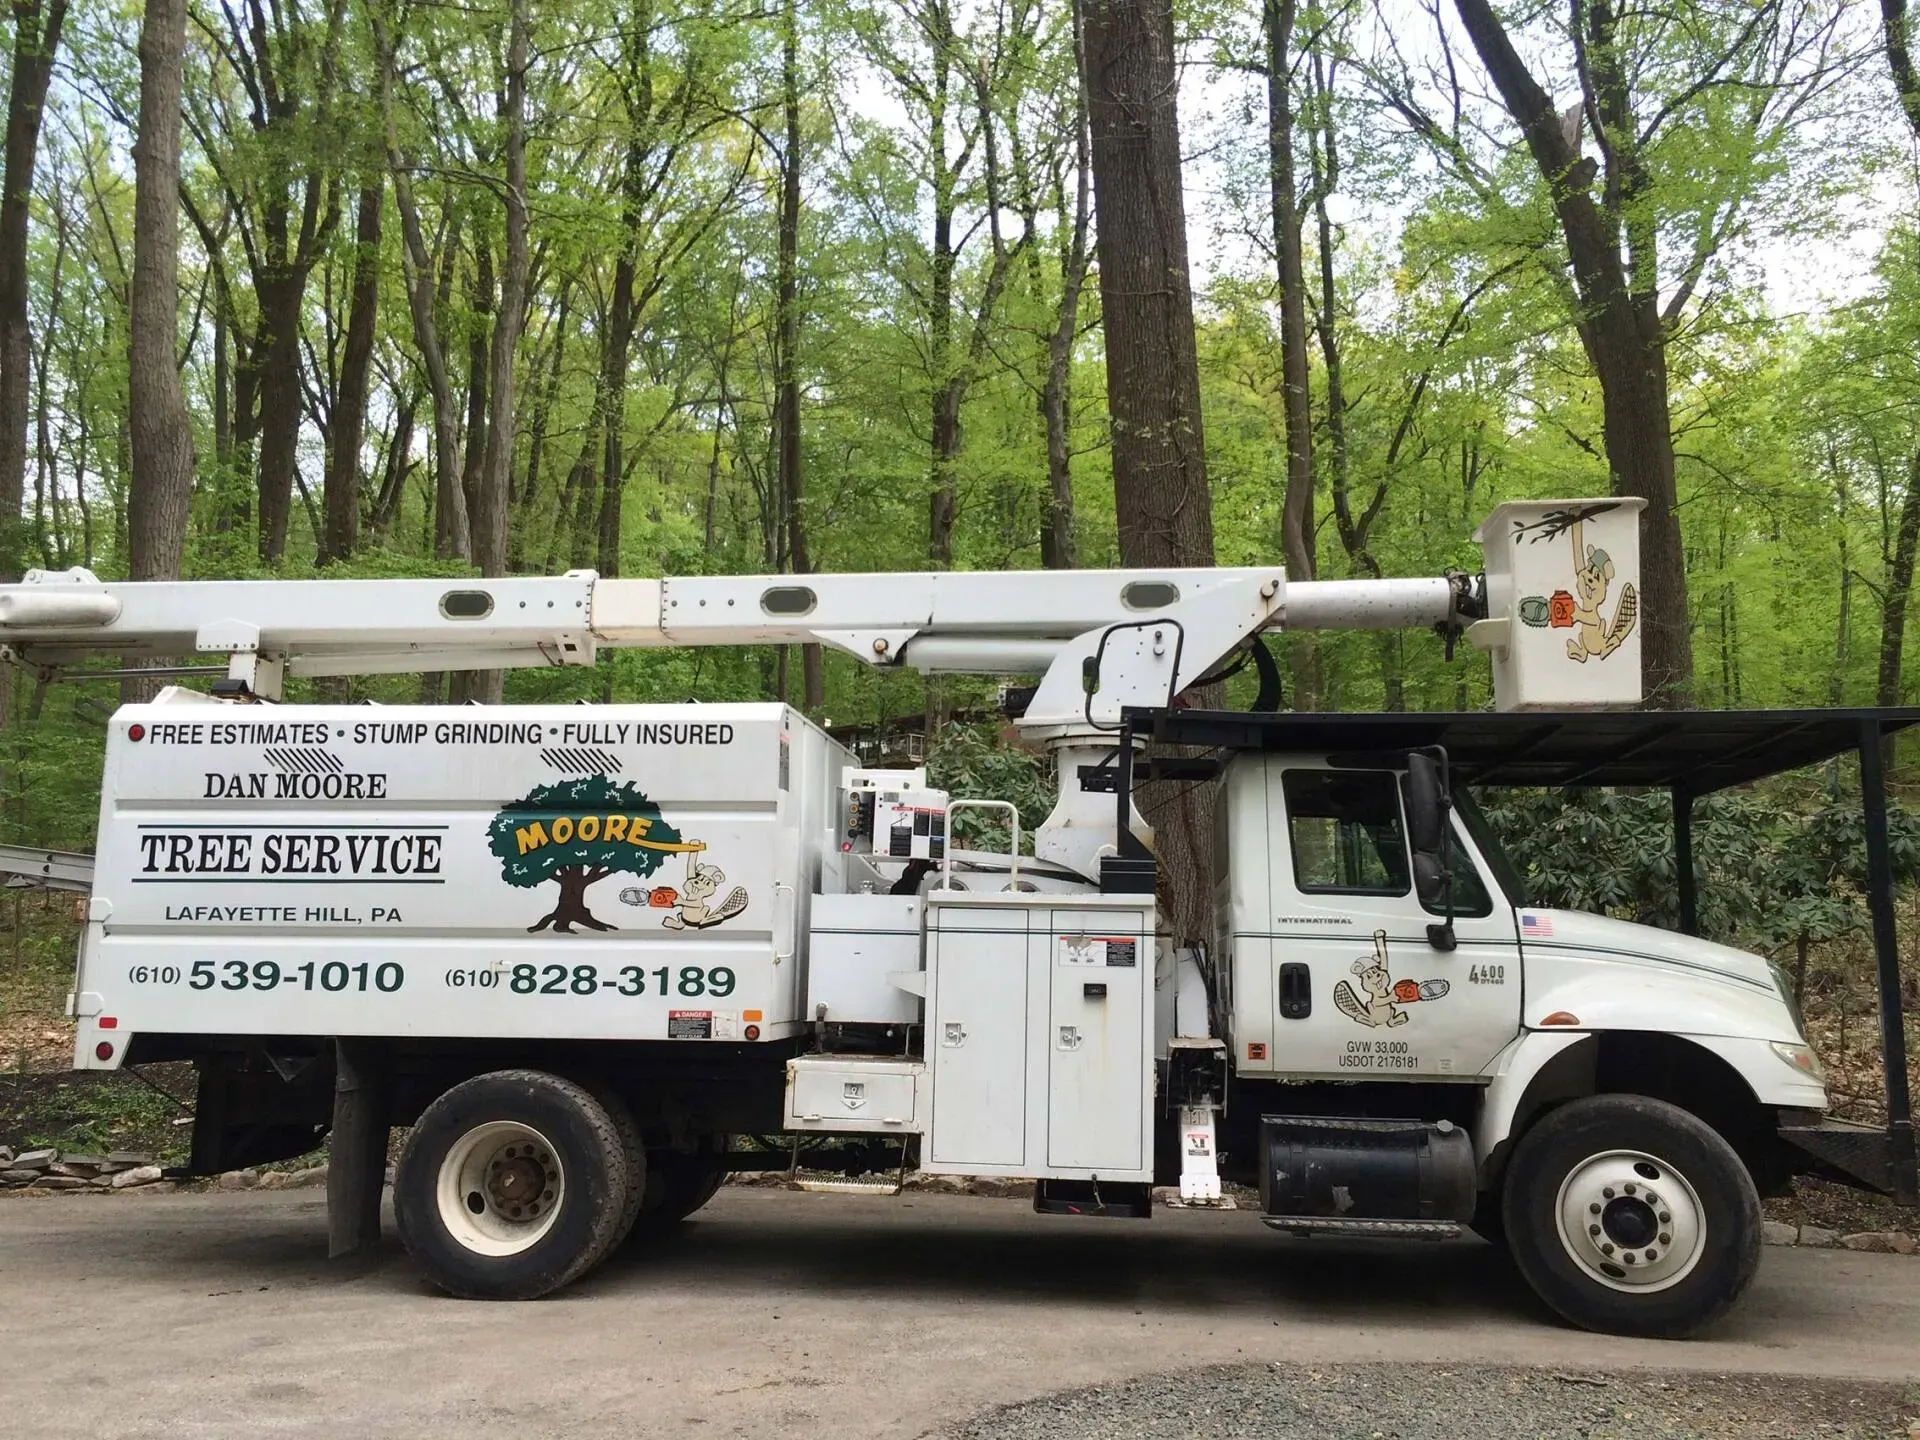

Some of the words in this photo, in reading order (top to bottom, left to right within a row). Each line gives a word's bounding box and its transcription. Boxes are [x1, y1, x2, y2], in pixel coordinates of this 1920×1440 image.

[150, 724, 204, 745] FREE
[210, 724, 330, 745] ESTIMATES
[353, 724, 429, 744] STUMP
[434, 723, 543, 745] GRINDING
[563, 724, 630, 744] FULLY
[636, 724, 734, 745] INSURED
[203, 773, 268, 799] DAN
[274, 773, 387, 799] MOORE
[515, 815, 655, 856] MOORE
[140, 835, 253, 873] TREE
[261, 835, 442, 874] SERVICE
[165, 906, 297, 922] LAFAYETTE
[304, 907, 363, 925] HILL,
[371, 908, 403, 922] PA
[1278, 917, 1353, 925] INTERNATIONAL
[129, 965, 181, 984] (610)
[189, 960, 405, 993] 539-1010
[445, 969, 500, 988] (610)
[509, 963, 736, 997] 828-3189
[1468, 964, 1505, 984] 4400
[1346, 1040, 1372, 1053] GVW
[1338, 1055, 1375, 1067] USDOT
[1377, 1055, 1419, 1068] 2176181
